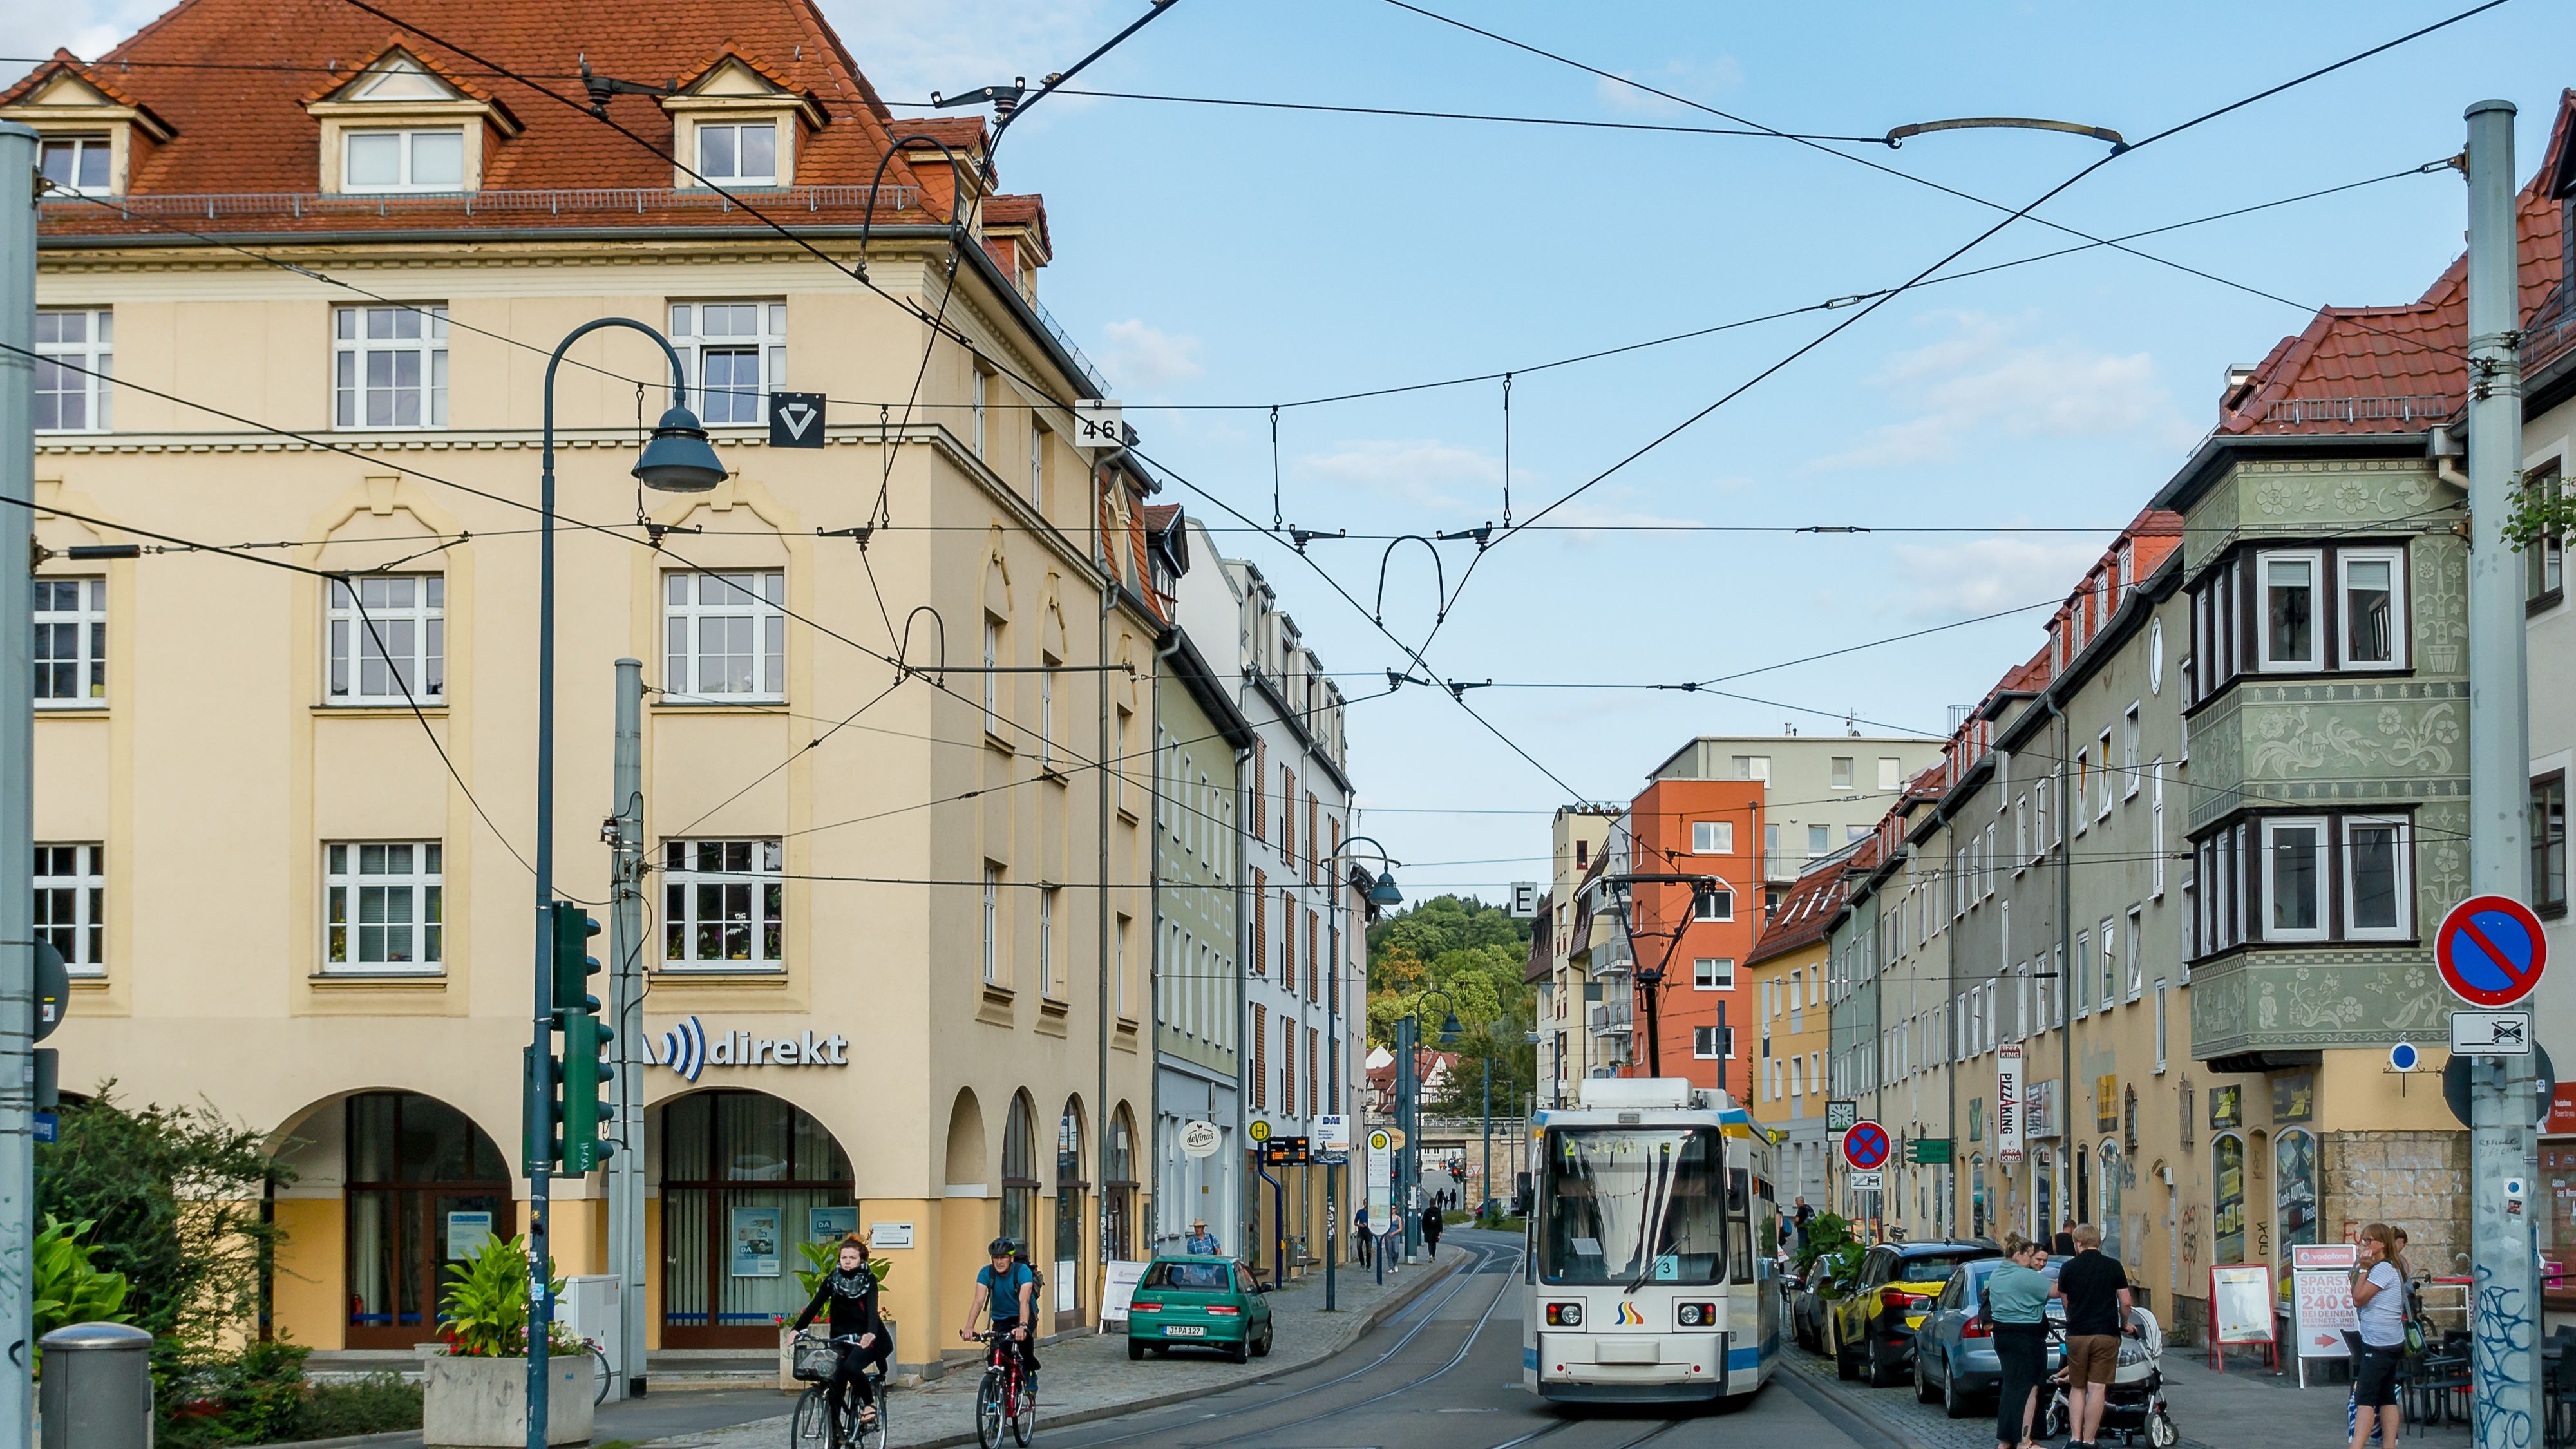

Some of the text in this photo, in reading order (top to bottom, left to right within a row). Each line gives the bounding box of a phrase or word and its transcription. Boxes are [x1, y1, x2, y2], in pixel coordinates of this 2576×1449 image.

[1083, 420, 1115, 440] 46
[1516, 887, 1532, 912] E
[709, 1030, 849, 1065] direkt
[1255, 1124, 1264, 1137] H
[1376, 1137, 1383, 1146] H
[1566, 1137, 1576, 1156] 2
[1662, 1262, 1671, 1274] 3
[2302, 1295, 2353, 1310] 240 €
